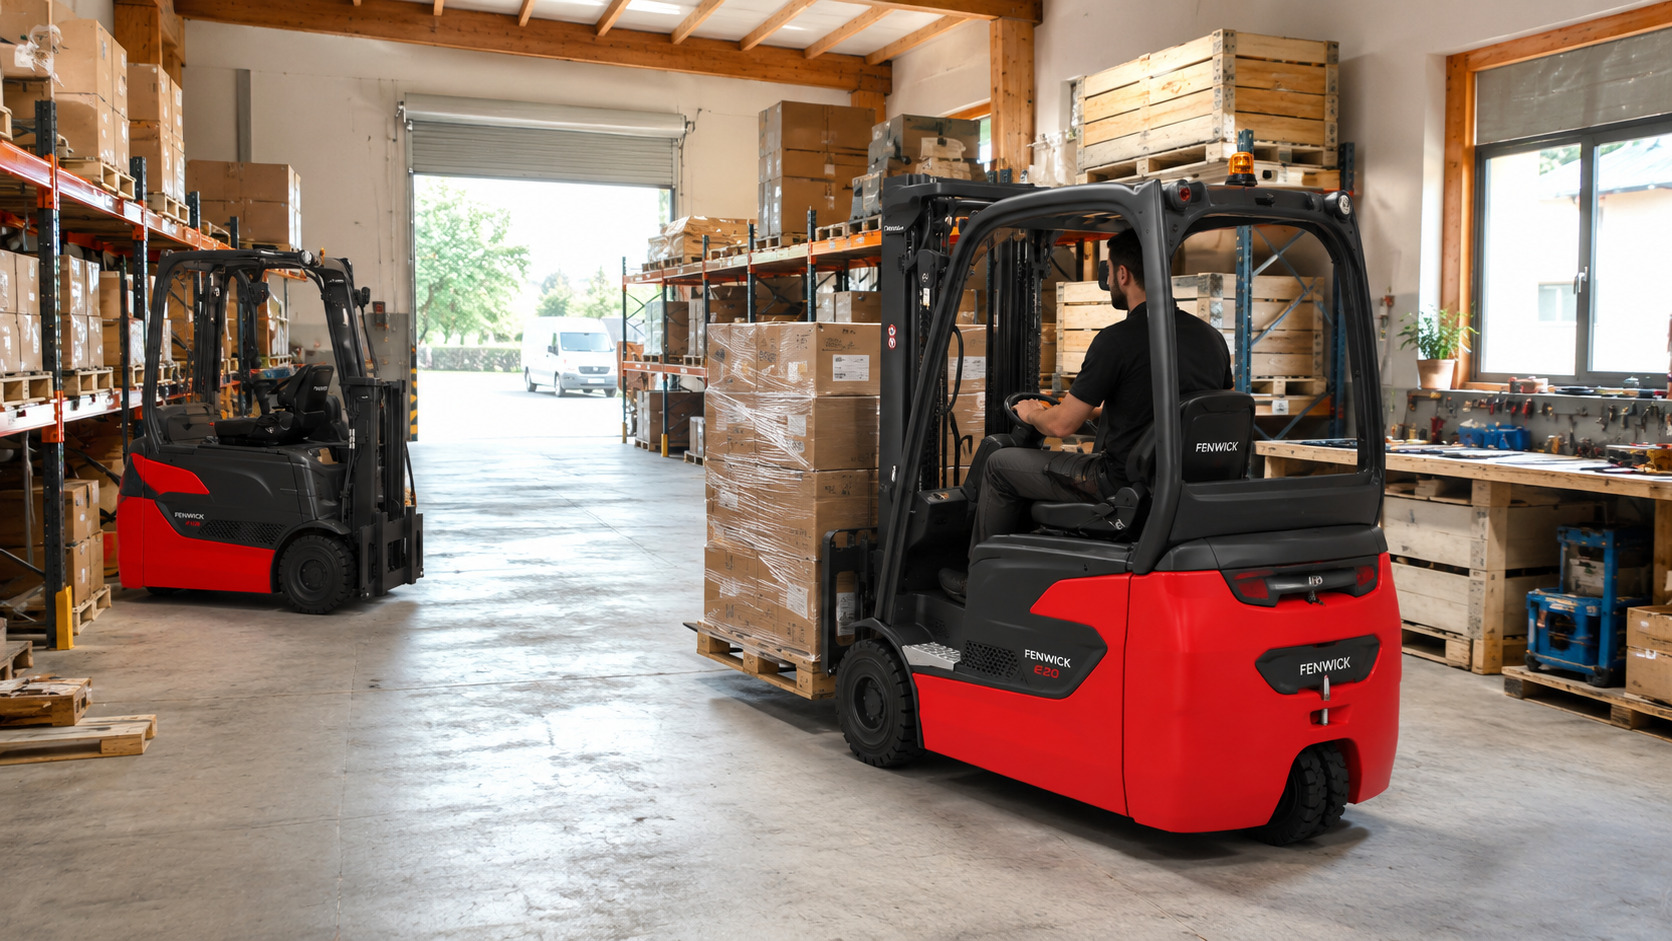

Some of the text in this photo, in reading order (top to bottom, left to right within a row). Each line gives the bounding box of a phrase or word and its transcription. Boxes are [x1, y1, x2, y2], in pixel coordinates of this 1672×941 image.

[1195, 441, 1239, 453] FENWICK
[1024, 648, 1071, 668] FENWICK
[1299, 656, 1351, 676] FENWICK
[1033, 664, 1060, 679] E20
